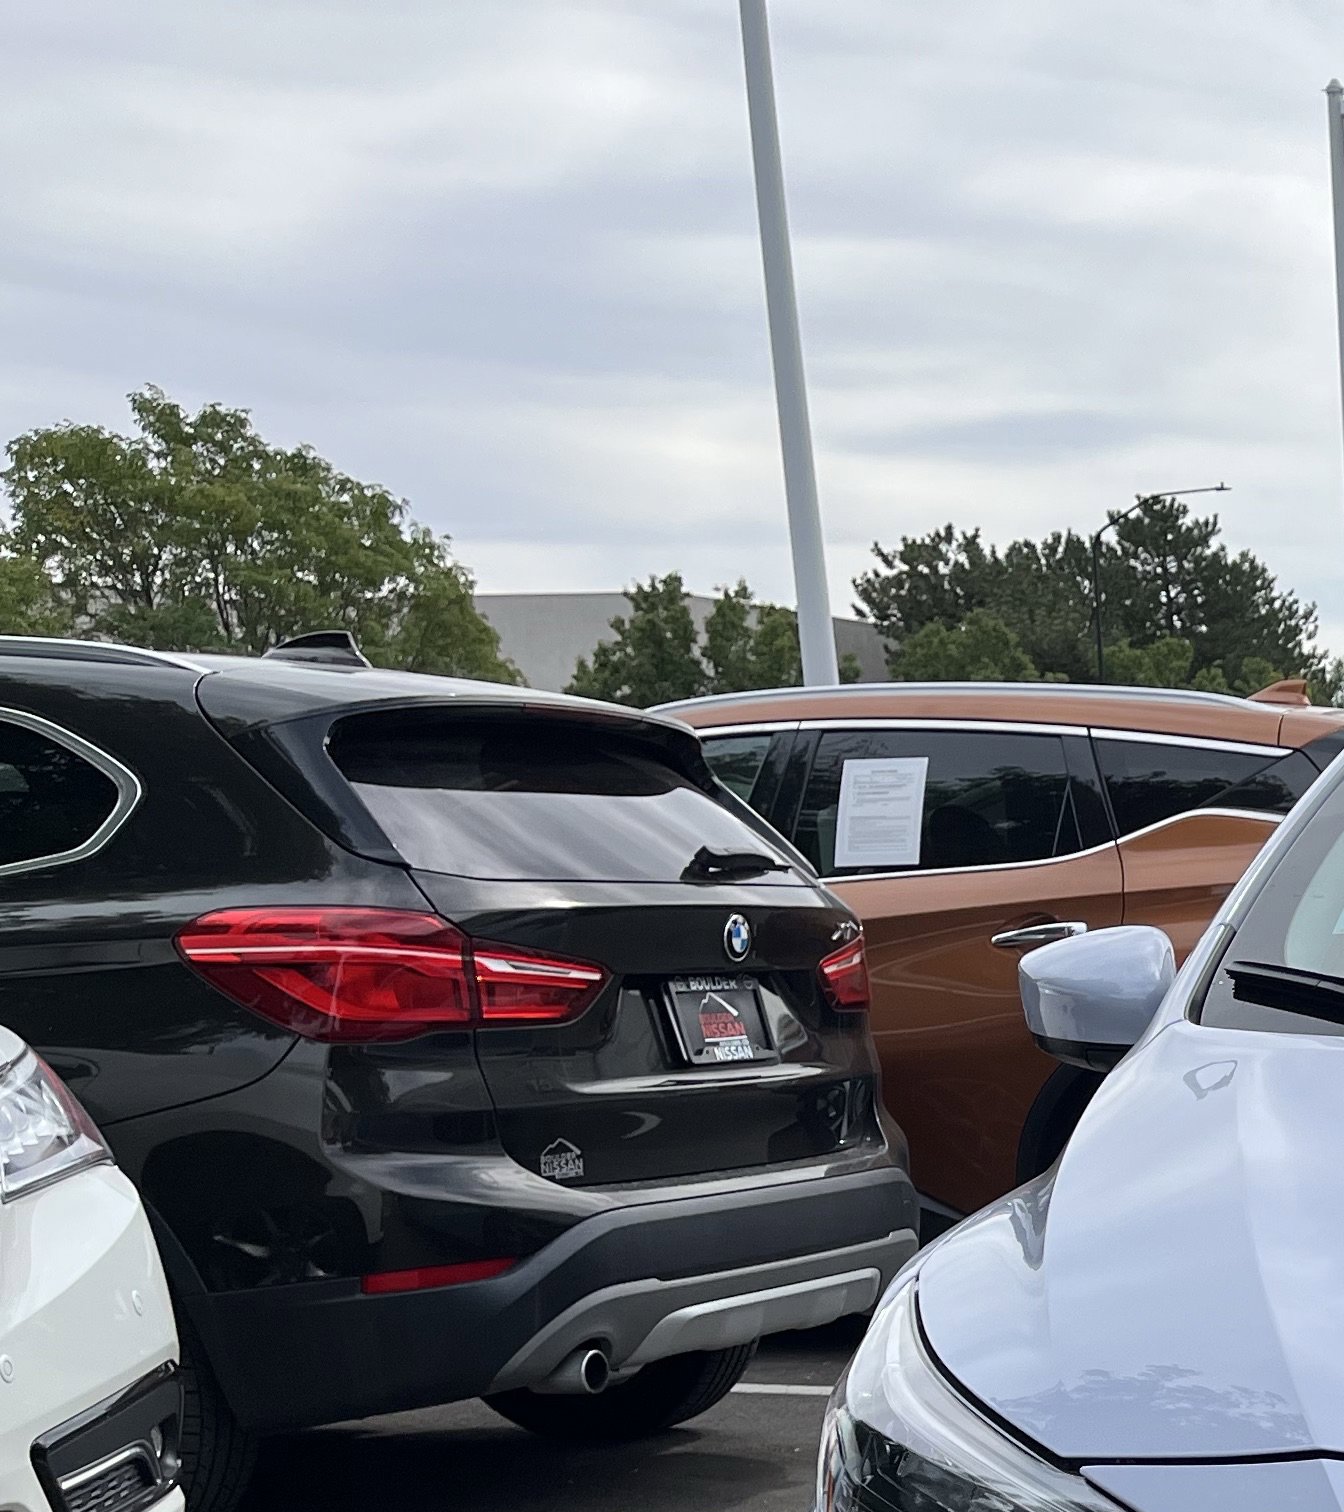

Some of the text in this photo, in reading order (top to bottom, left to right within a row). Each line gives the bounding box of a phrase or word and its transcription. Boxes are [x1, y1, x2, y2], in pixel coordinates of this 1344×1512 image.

[688, 976, 738, 990] BOULDER
[701, 1021, 747, 1038] NISSAN
[714, 1045, 754, 1061] NISSAN
